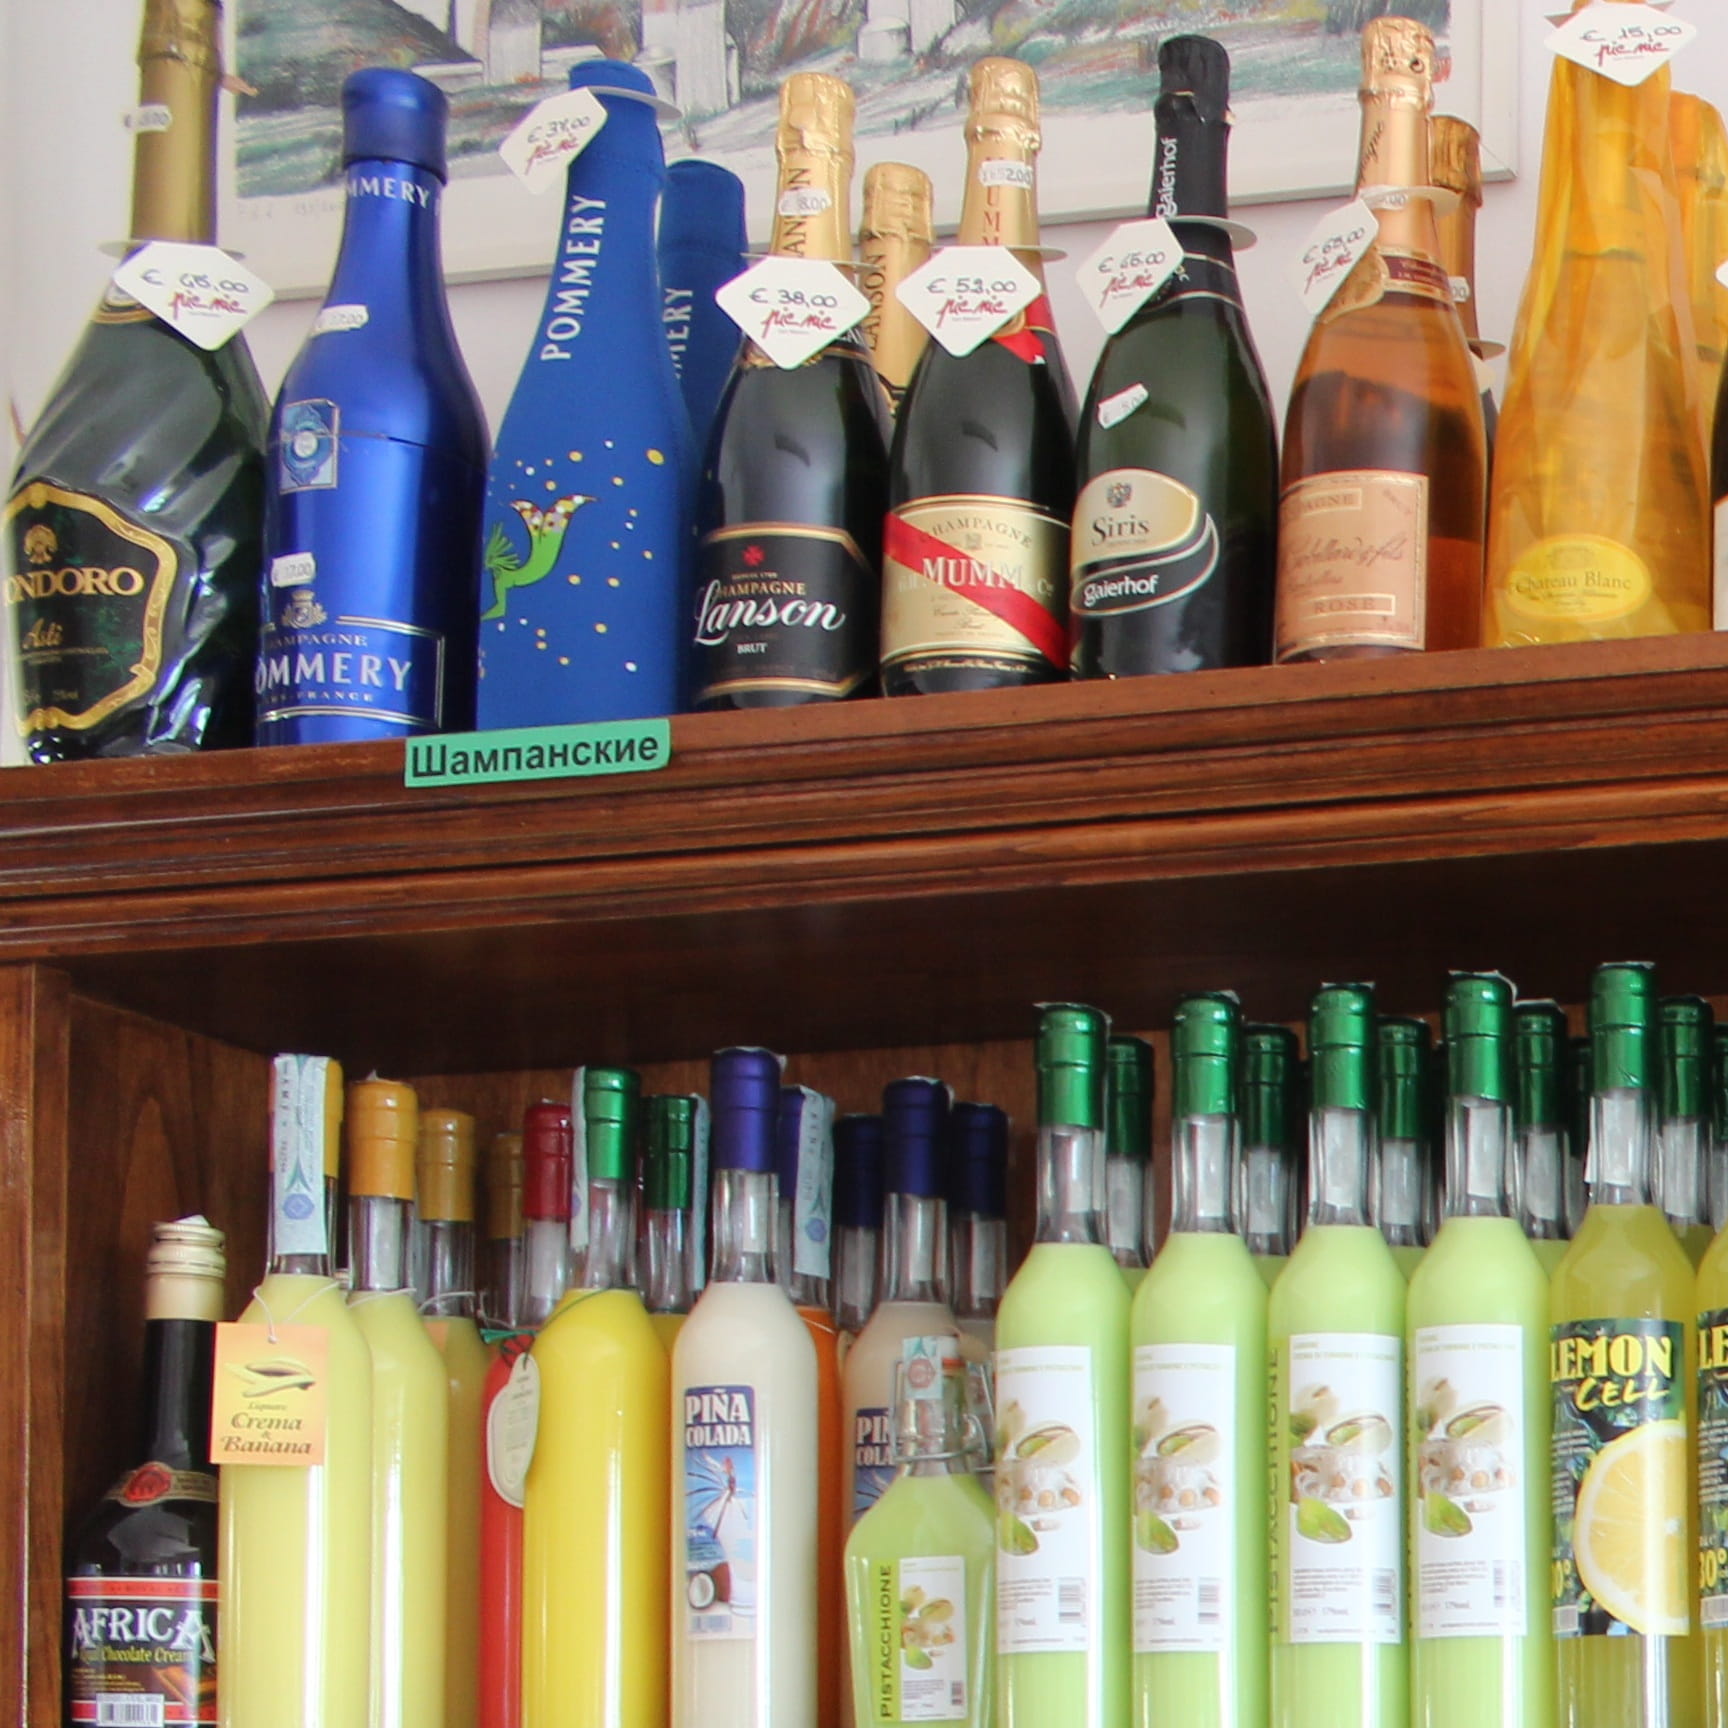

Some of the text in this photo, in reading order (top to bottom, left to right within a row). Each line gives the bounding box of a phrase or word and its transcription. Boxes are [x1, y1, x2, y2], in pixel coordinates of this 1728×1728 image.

[540, 195, 606, 361] POMMERY
[1091, 514, 1150, 544] Siris
[922, 558, 1024, 591] MUMM
[1084, 574, 1159, 606] gaierhof
[693, 579, 846, 645] Lanson
[411, 733, 660, 780] Шампанские
[1551, 1333, 1674, 1384] LEMON
[685, 1387, 749, 1426] PIÑA
[1575, 1374, 1669, 1412] CELL
[231, 1411, 302, 1432] Crema
[685, 1426, 752, 1449] COLADA
[221, 1436, 312, 1457] Banana
[880, 1563, 892, 1719] PISTACCHIONE
